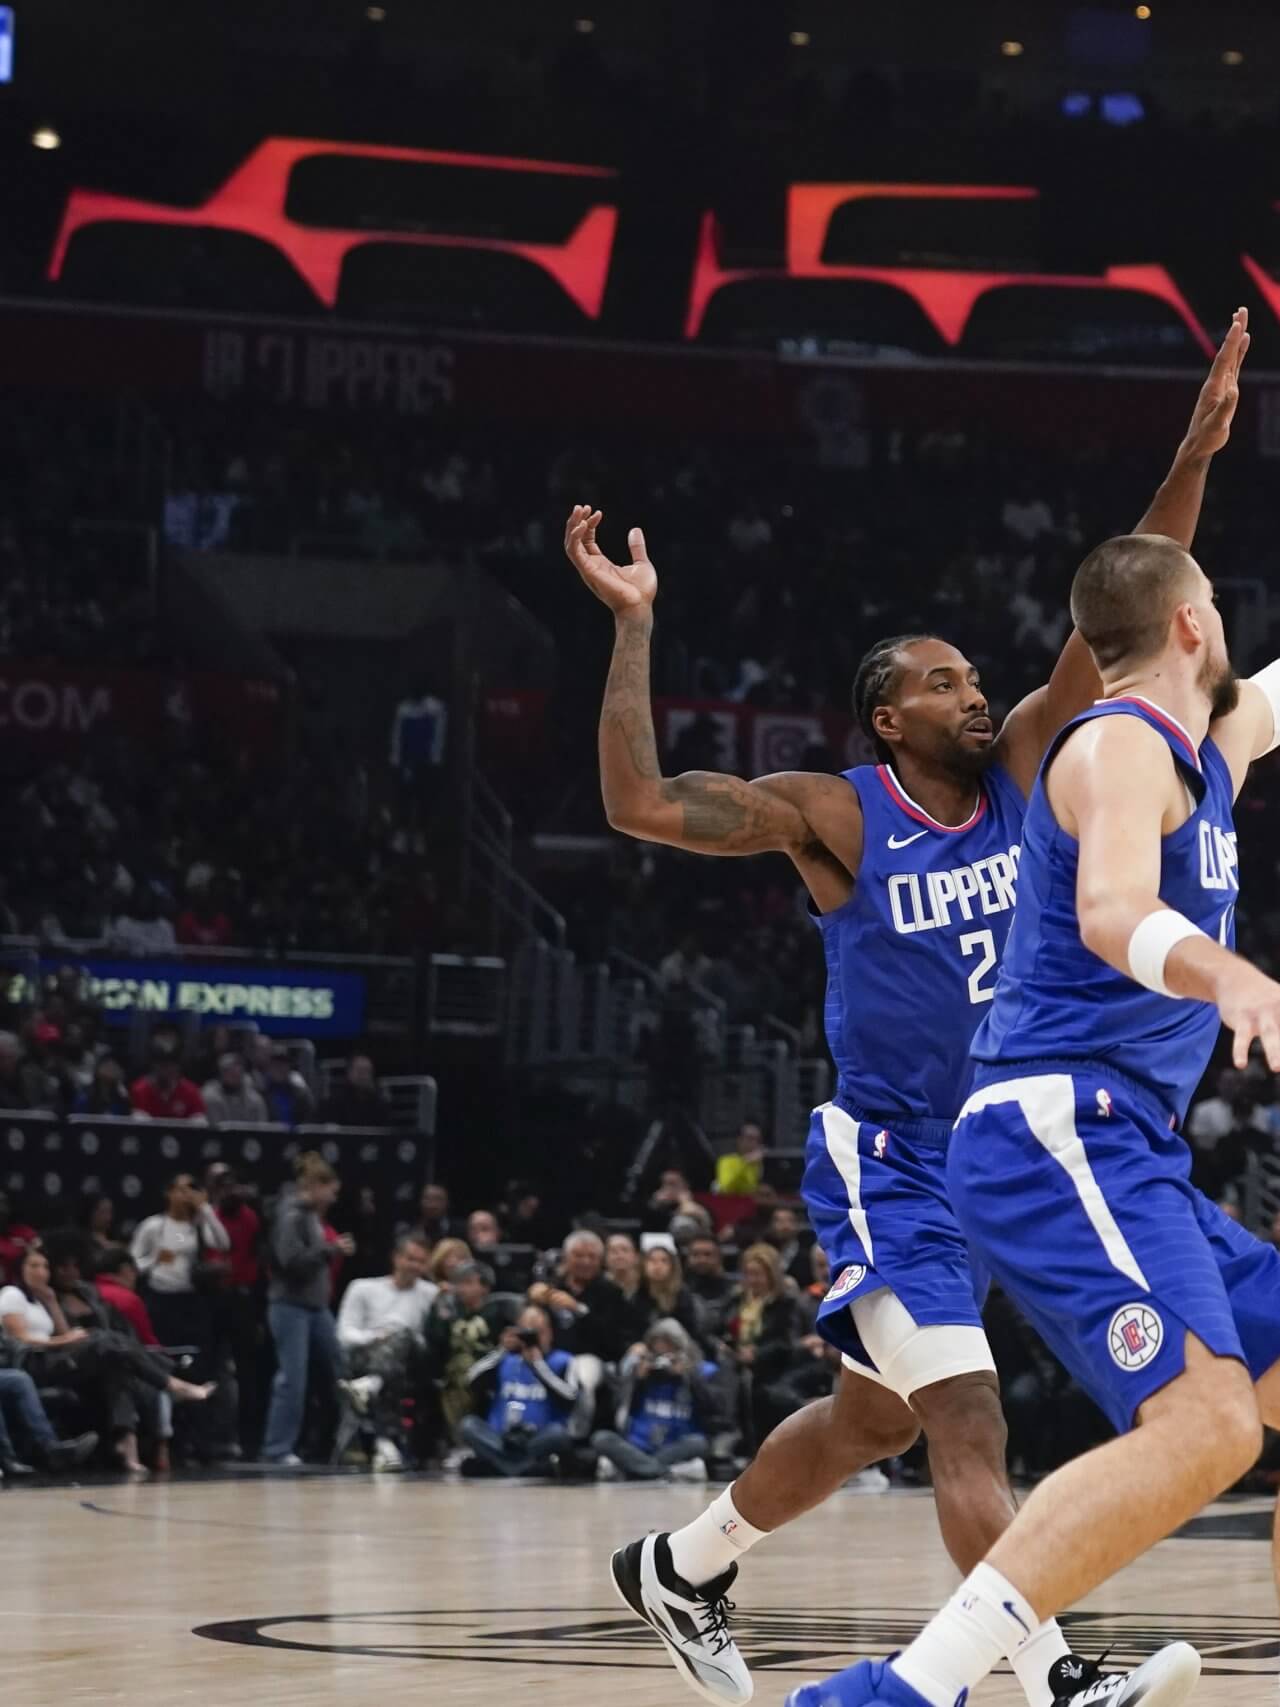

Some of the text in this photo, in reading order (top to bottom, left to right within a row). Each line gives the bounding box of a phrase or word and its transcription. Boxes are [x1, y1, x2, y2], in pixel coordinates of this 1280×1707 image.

[0, 679, 112, 733] OM
[959, 928, 998, 1005] 2
[178, 981, 336, 1020] EXPRESS
